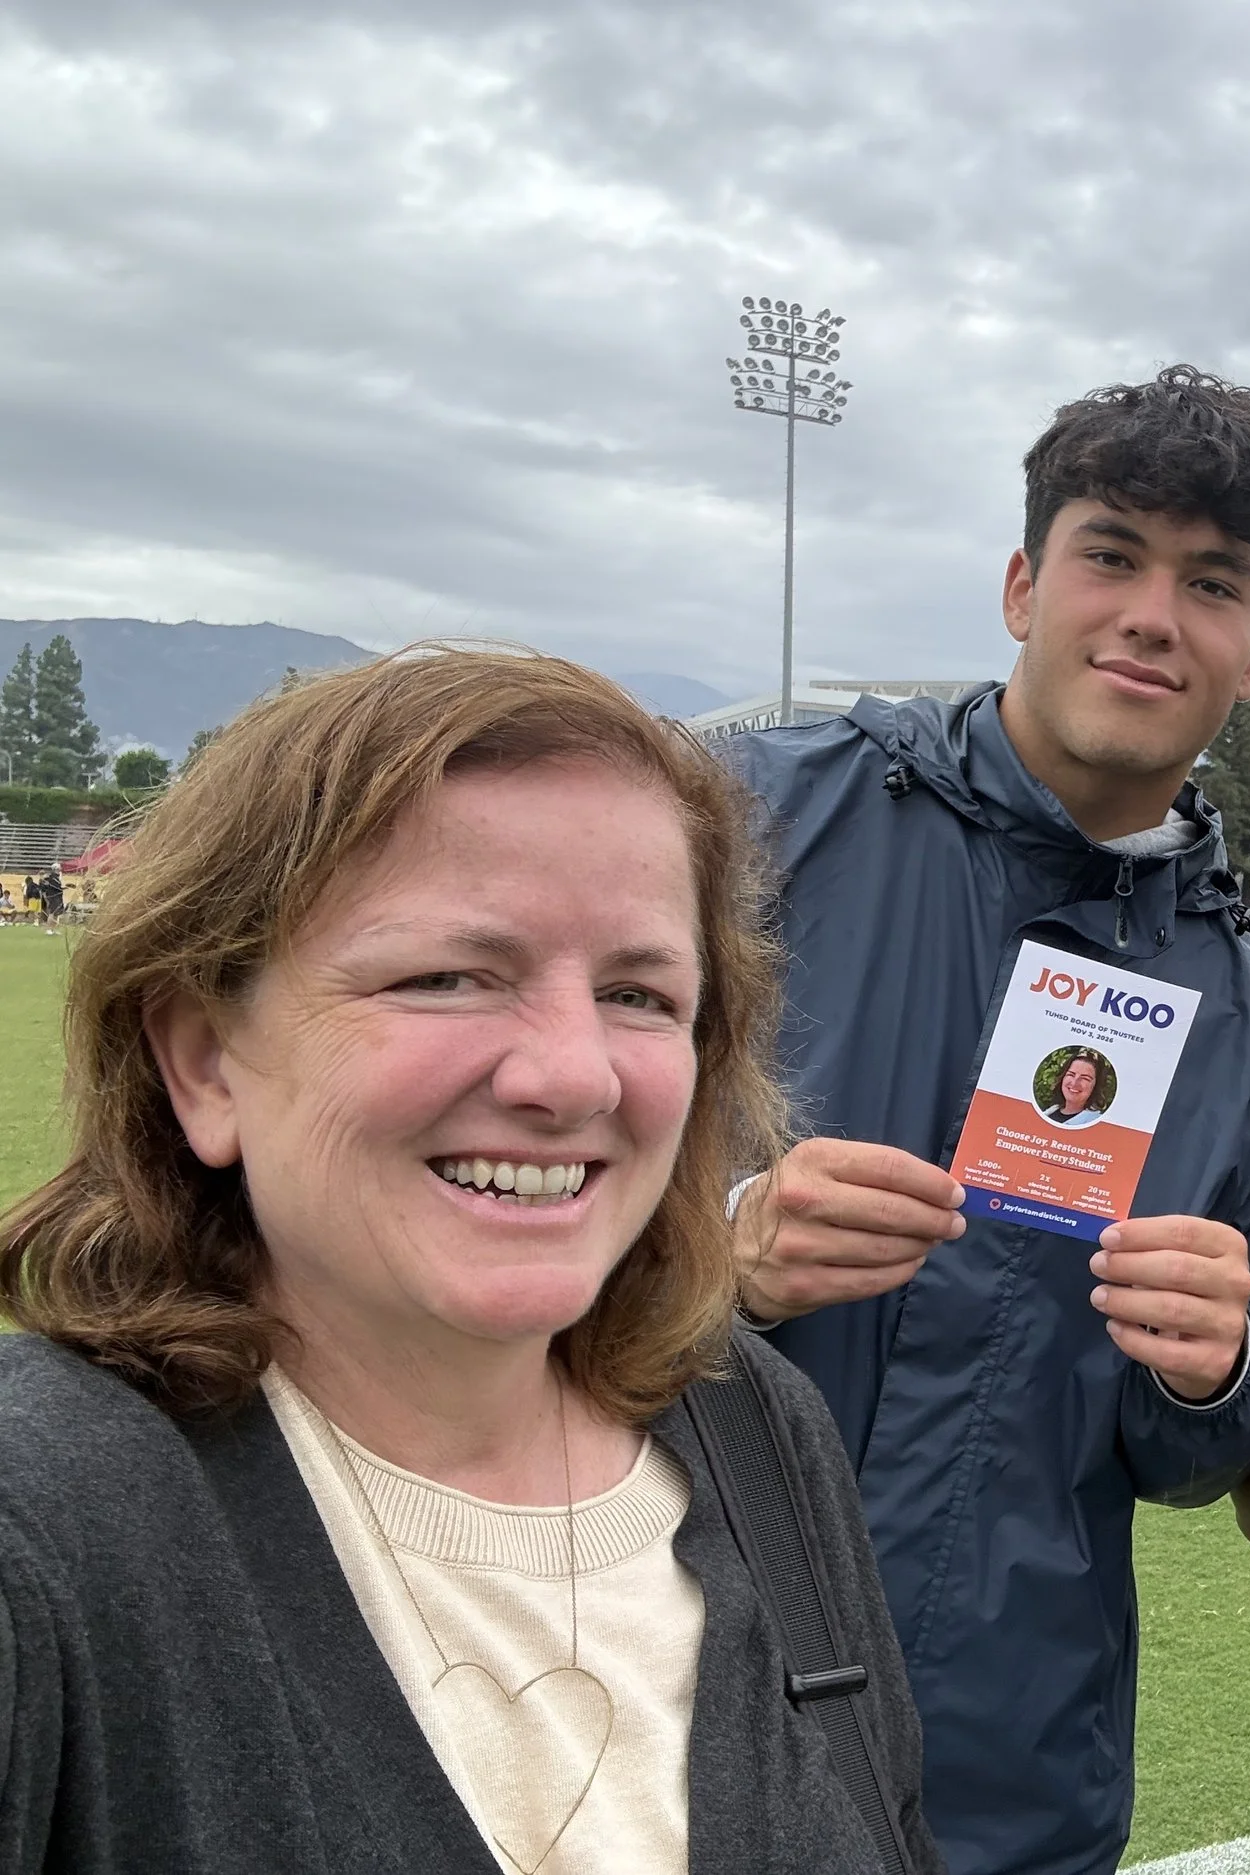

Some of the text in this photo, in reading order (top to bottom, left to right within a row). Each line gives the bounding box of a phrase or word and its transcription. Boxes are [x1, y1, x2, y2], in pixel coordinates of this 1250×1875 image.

[1029, 967, 1174, 1029] JOY KOO
[1044, 1009, 1069, 1022] TUHSD
[1070, 1017, 1096, 1030] BOARD
[1110, 1029, 1145, 1043] TRUSTEES
[1070, 1026, 1114, 1044] NOV 3, 2026
[995, 1138, 1106, 1173] Empower Every Student.
[996, 1126, 1113, 1162] Choose Joy. Restore Trust.
[988, 1172, 1009, 1181] service
[1002, 1203, 1077, 1227] joyfortamdistrict.org
